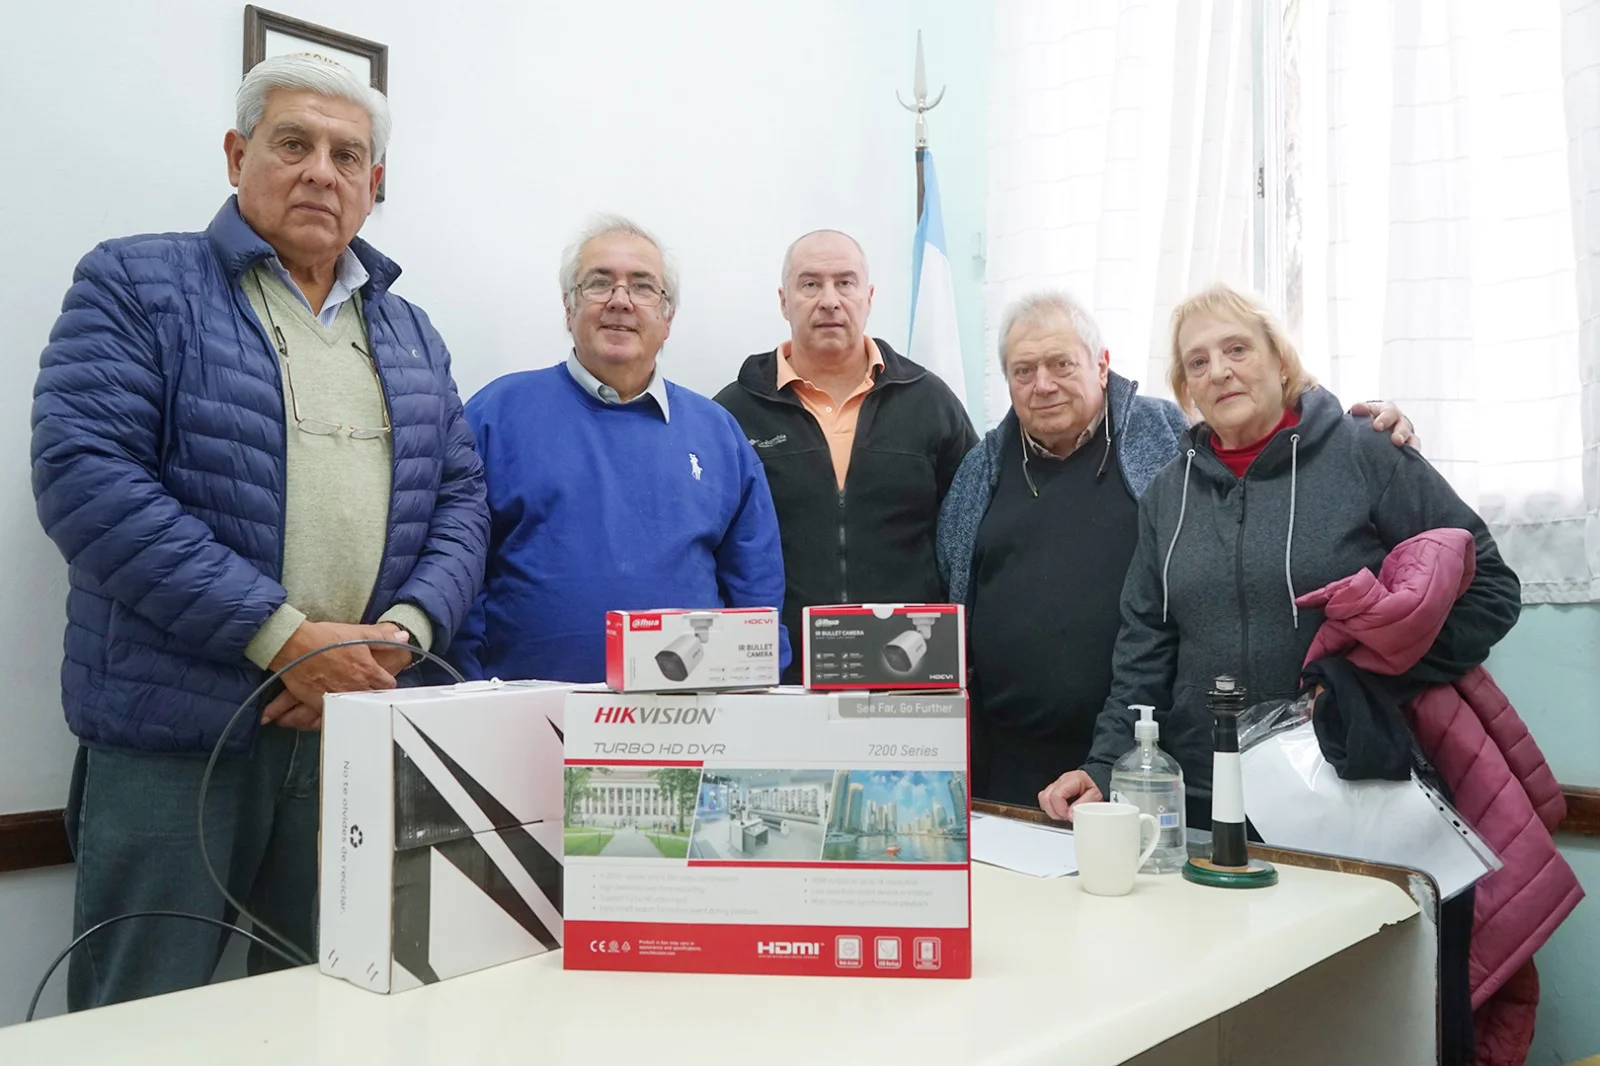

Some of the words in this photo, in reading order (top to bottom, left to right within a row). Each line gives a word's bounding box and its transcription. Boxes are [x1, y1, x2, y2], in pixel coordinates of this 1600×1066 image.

[747, 643, 773, 651] BULLET
[856, 703, 876, 714] See
[878, 702, 897, 714] Far,
[900, 702, 913, 713] Go
[915, 702, 953, 713] Further
[594, 707, 716, 725] HIKVISION
[593, 742, 655, 754] TURBO
[658, 743, 684, 755] HD
[687, 743, 726, 755] DVR
[868, 743, 898, 757] 7200
[900, 744, 939, 757] Series
[342, 760, 350, 779] No
[342, 782, 350, 795] te
[340, 798, 350, 842] olvides
[340, 846, 349, 863] de
[757, 941, 820, 956] HDMI
